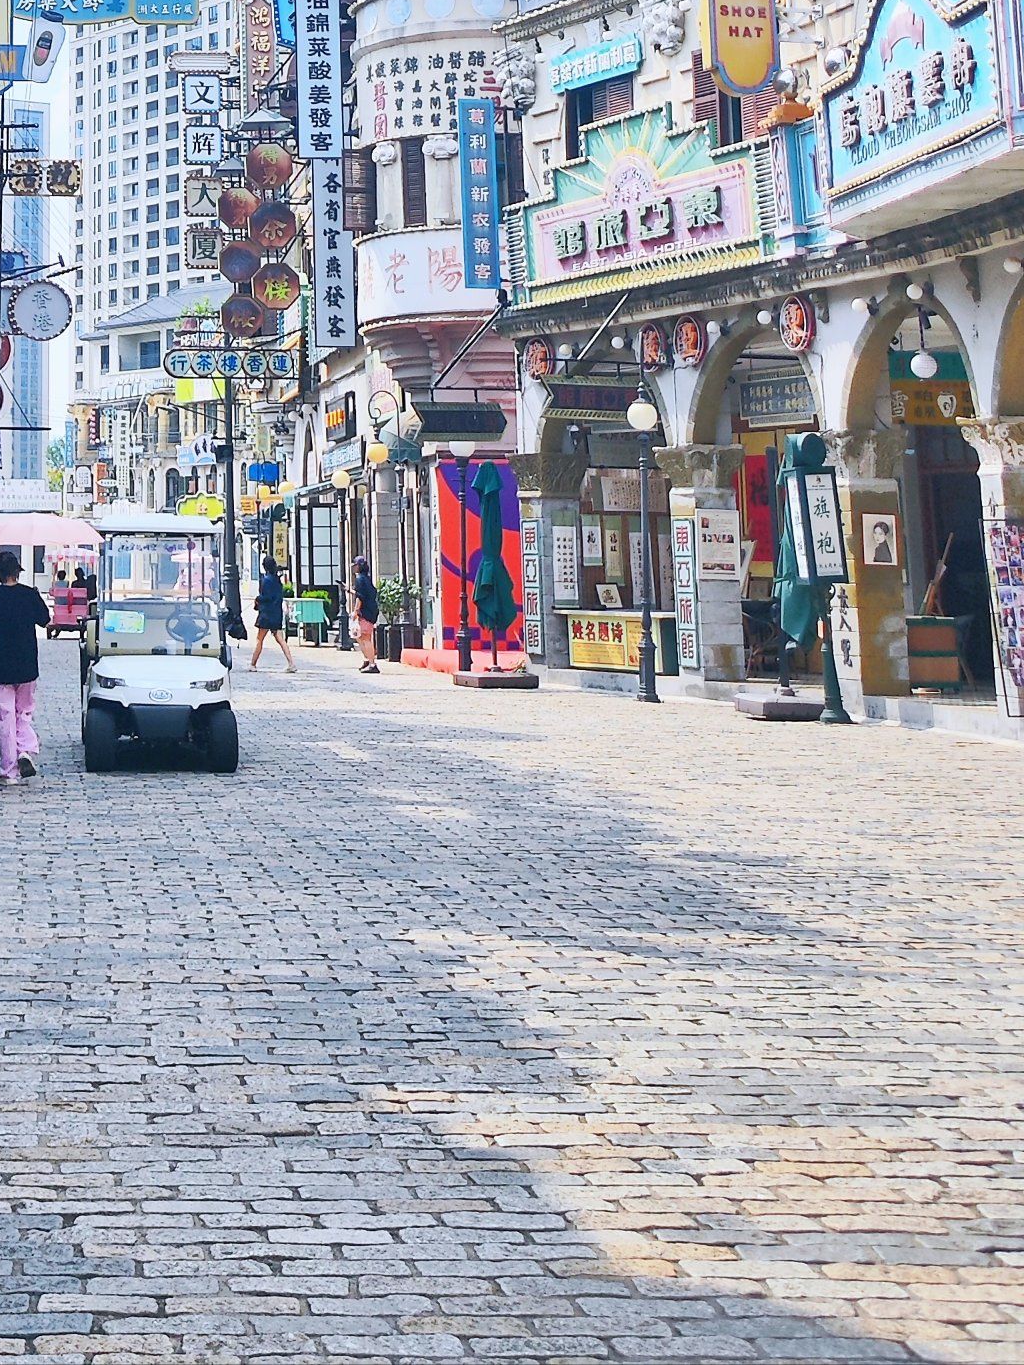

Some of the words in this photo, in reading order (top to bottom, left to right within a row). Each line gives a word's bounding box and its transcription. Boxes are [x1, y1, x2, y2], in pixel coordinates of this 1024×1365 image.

[719, 3, 767, 19] SHOE
[728, 25, 764, 39] HAT
[850, 138, 880, 166] CLOUD
[884, 107, 942, 151] CHEONGSAM
[945, 92, 973, 121] SHOP
[322, 157, 346, 338] 各省官燕發客
[572, 257, 608, 272] EAST
[614, 249, 647, 264] ASIA
[653, 238, 701, 254] HOTEL
[32, 289, 54, 331] 香港
[811, 494, 836, 555] 旗袍
[524, 524, 540, 649] 東亞旅館
[675, 524, 696, 661] 東亞旅館
